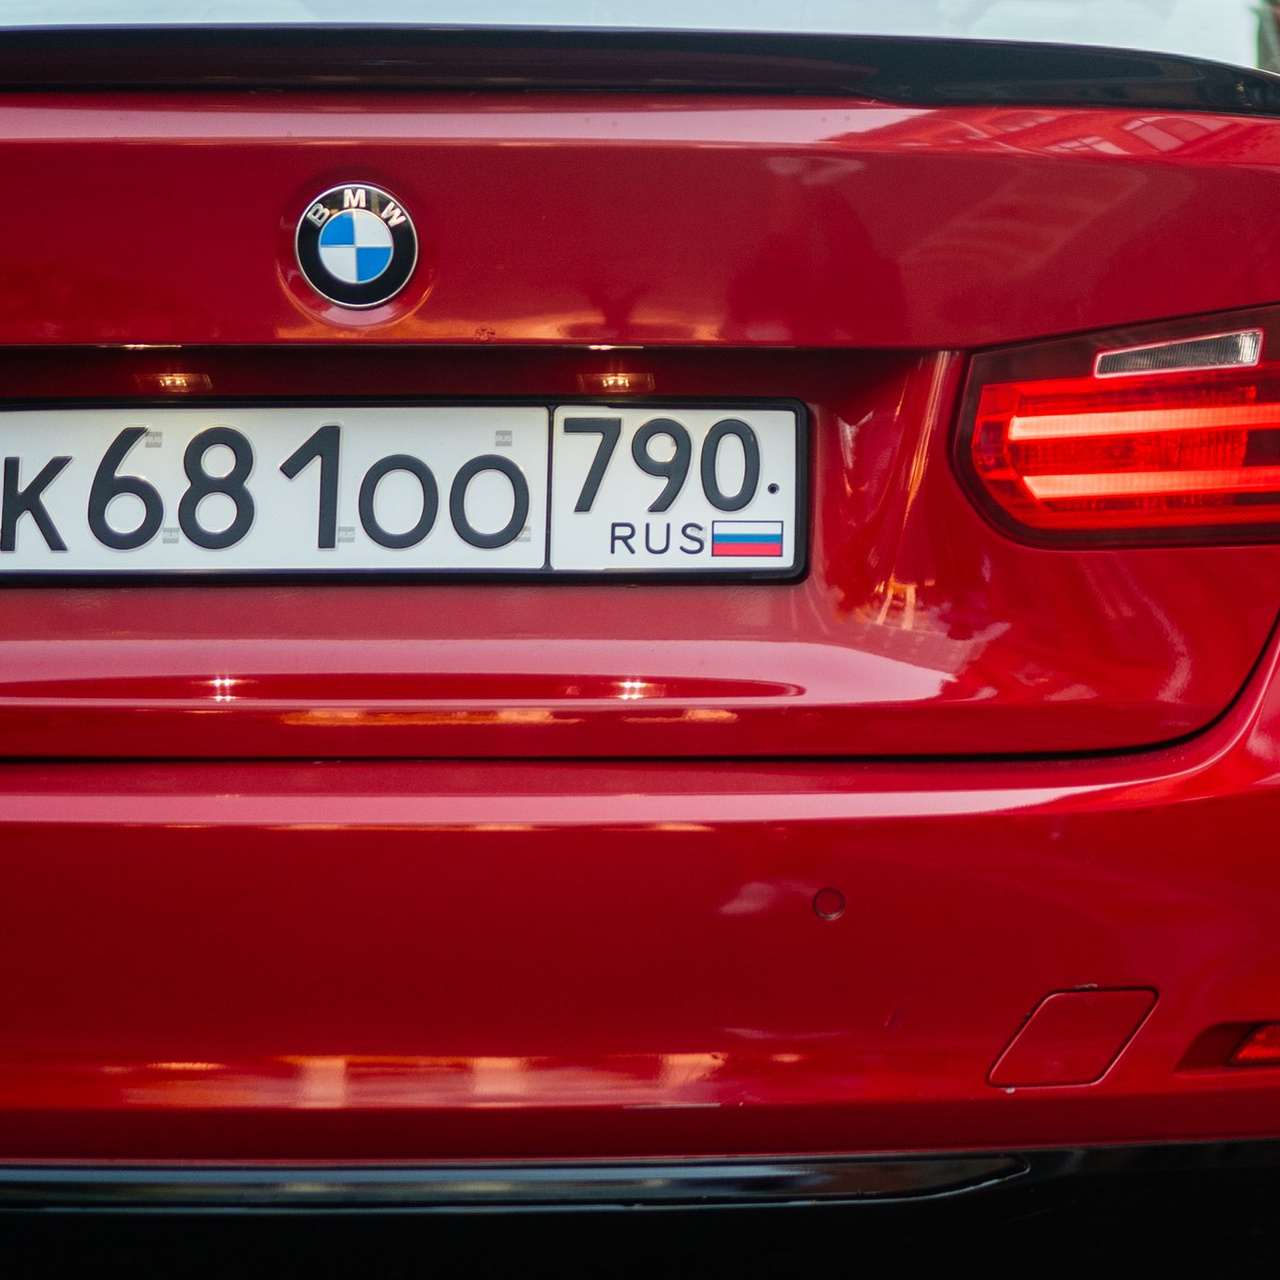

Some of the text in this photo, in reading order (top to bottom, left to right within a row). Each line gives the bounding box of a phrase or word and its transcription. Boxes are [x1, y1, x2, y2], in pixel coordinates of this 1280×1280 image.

[307, 188, 406, 227] BMW
[564, 418, 760, 512] 790
[610, 523, 705, 554] RUS
